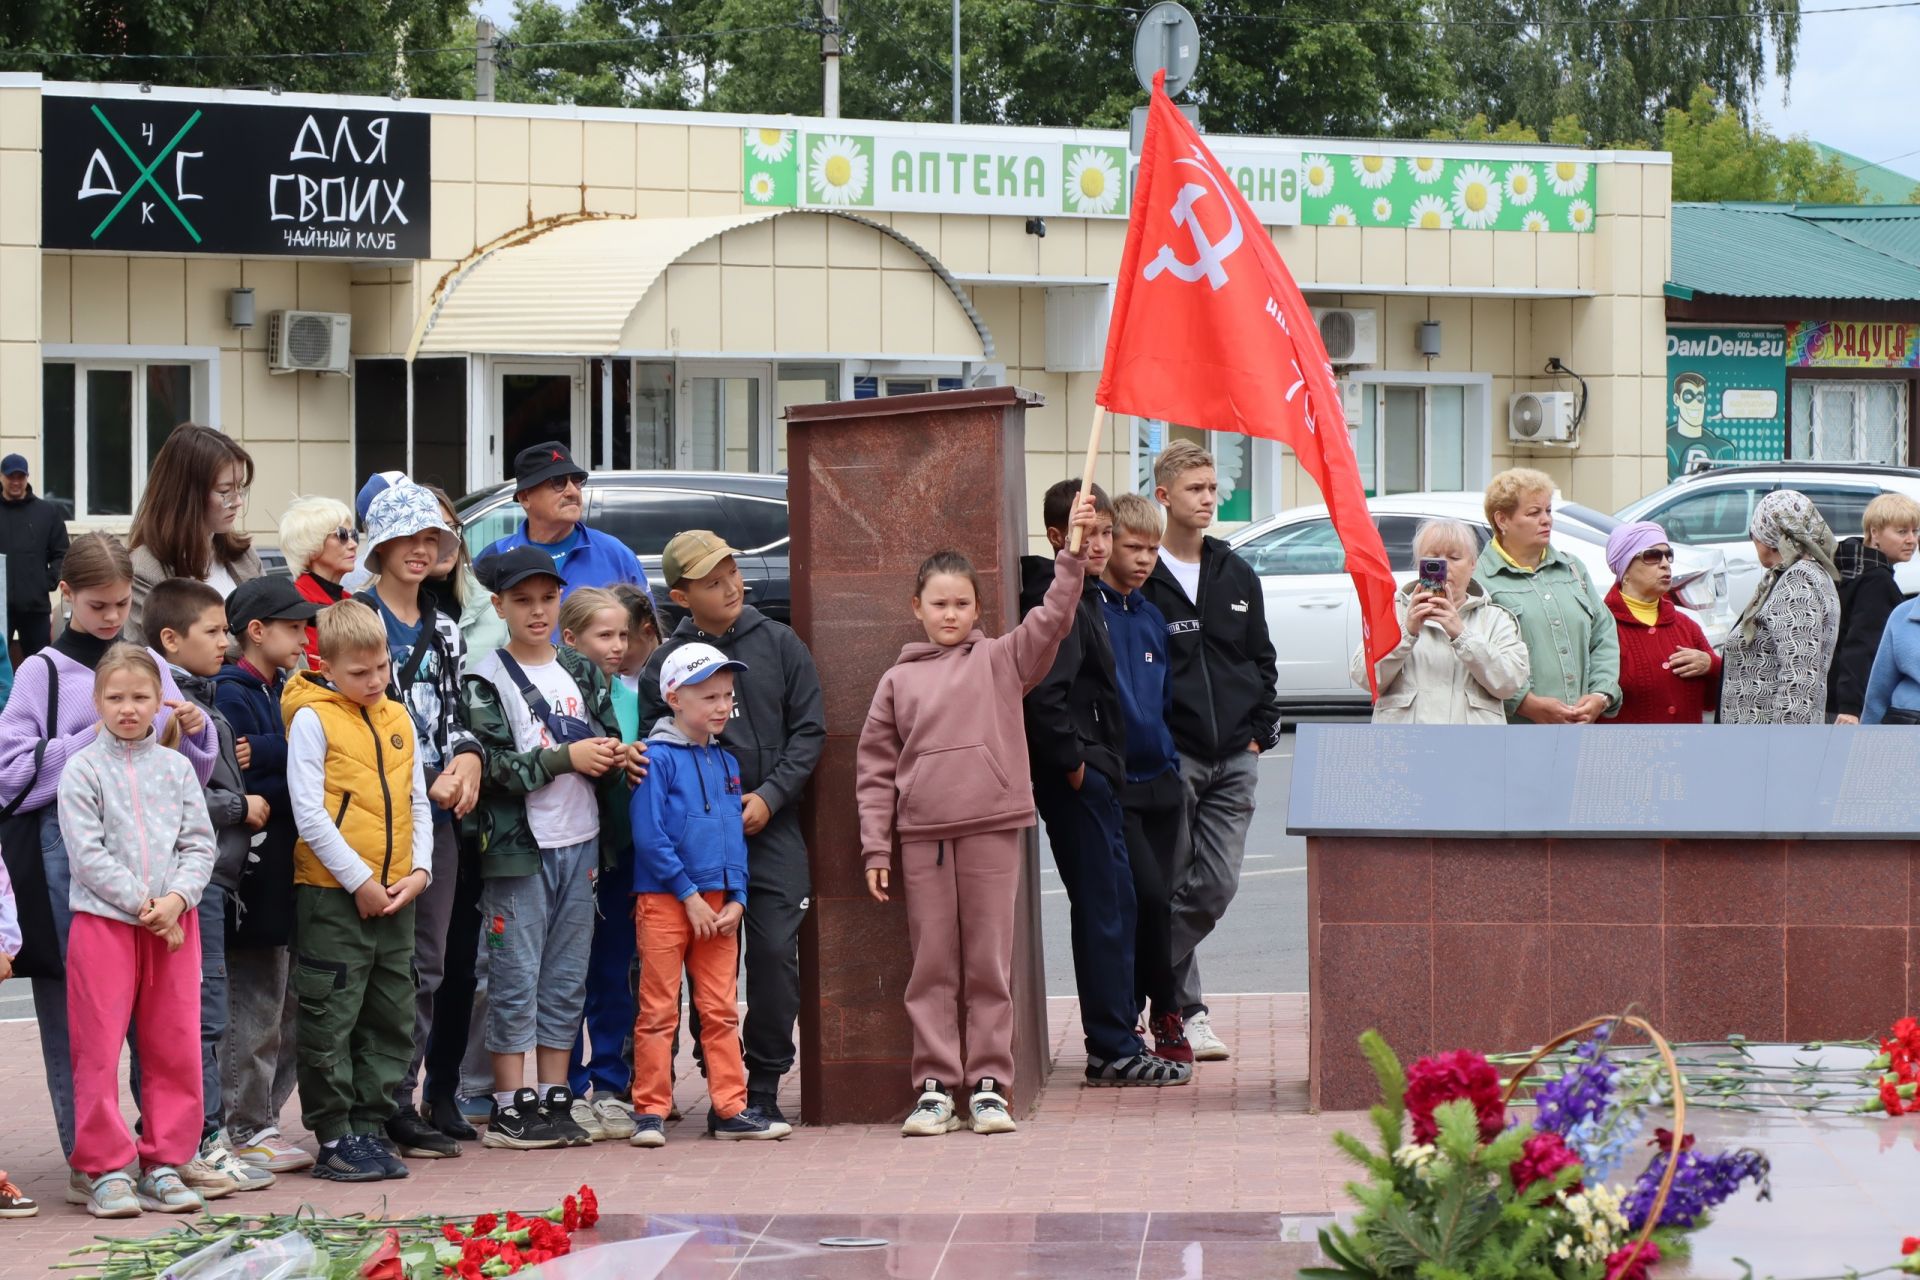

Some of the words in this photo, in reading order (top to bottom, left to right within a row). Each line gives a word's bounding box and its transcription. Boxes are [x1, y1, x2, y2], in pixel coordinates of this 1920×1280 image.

[290, 114, 390, 164] ДЛЯ
[891, 150, 1045, 198] АПТЕКА
[269, 173, 410, 225] СВОИХ
[283, 225, 351, 249] ЧАЙНЫЙ
[355, 231, 396, 250] КЛУБ
[1834, 323, 1906, 362] РАДУГА
